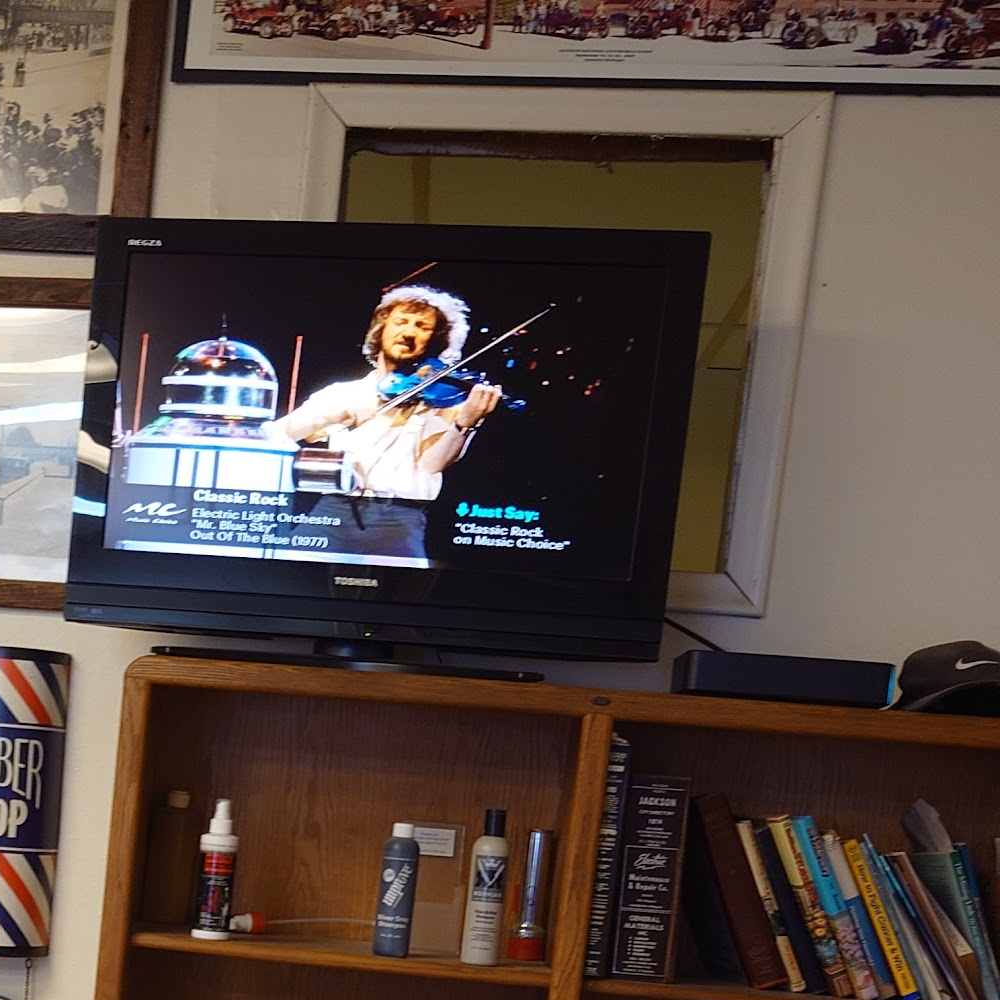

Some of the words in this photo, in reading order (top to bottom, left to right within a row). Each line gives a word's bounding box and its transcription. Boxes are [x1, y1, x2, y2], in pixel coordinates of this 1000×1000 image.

[193, 489, 248, 505] Classic
[249, 492, 289, 507] Rock
[191, 507, 240, 521] Electric
[241, 510, 275, 524] Light
[277, 512, 341, 526] Orchestra
[470, 504, 503, 519] Just
[504, 506, 540, 522] Say:
[219, 520, 247, 532] Blue
[249, 522, 277, 535] Sky"
[510, 525, 544, 538] Rock
[189, 530, 215, 542] Out
[216, 531, 234, 542] Of
[235, 532, 260, 544] The
[261, 533, 290, 546] Blue
[291, 535, 329, 548] (1977)
[453, 535, 472, 546] on
[474, 535, 514, 548] Music
[516, 537, 571, 551] Choice"
[333, 576, 379, 588] TOSHIBA
[638, 796, 678, 807] JACKSON
[857, 864, 868, 883] How
[891, 955, 904, 972] Win
